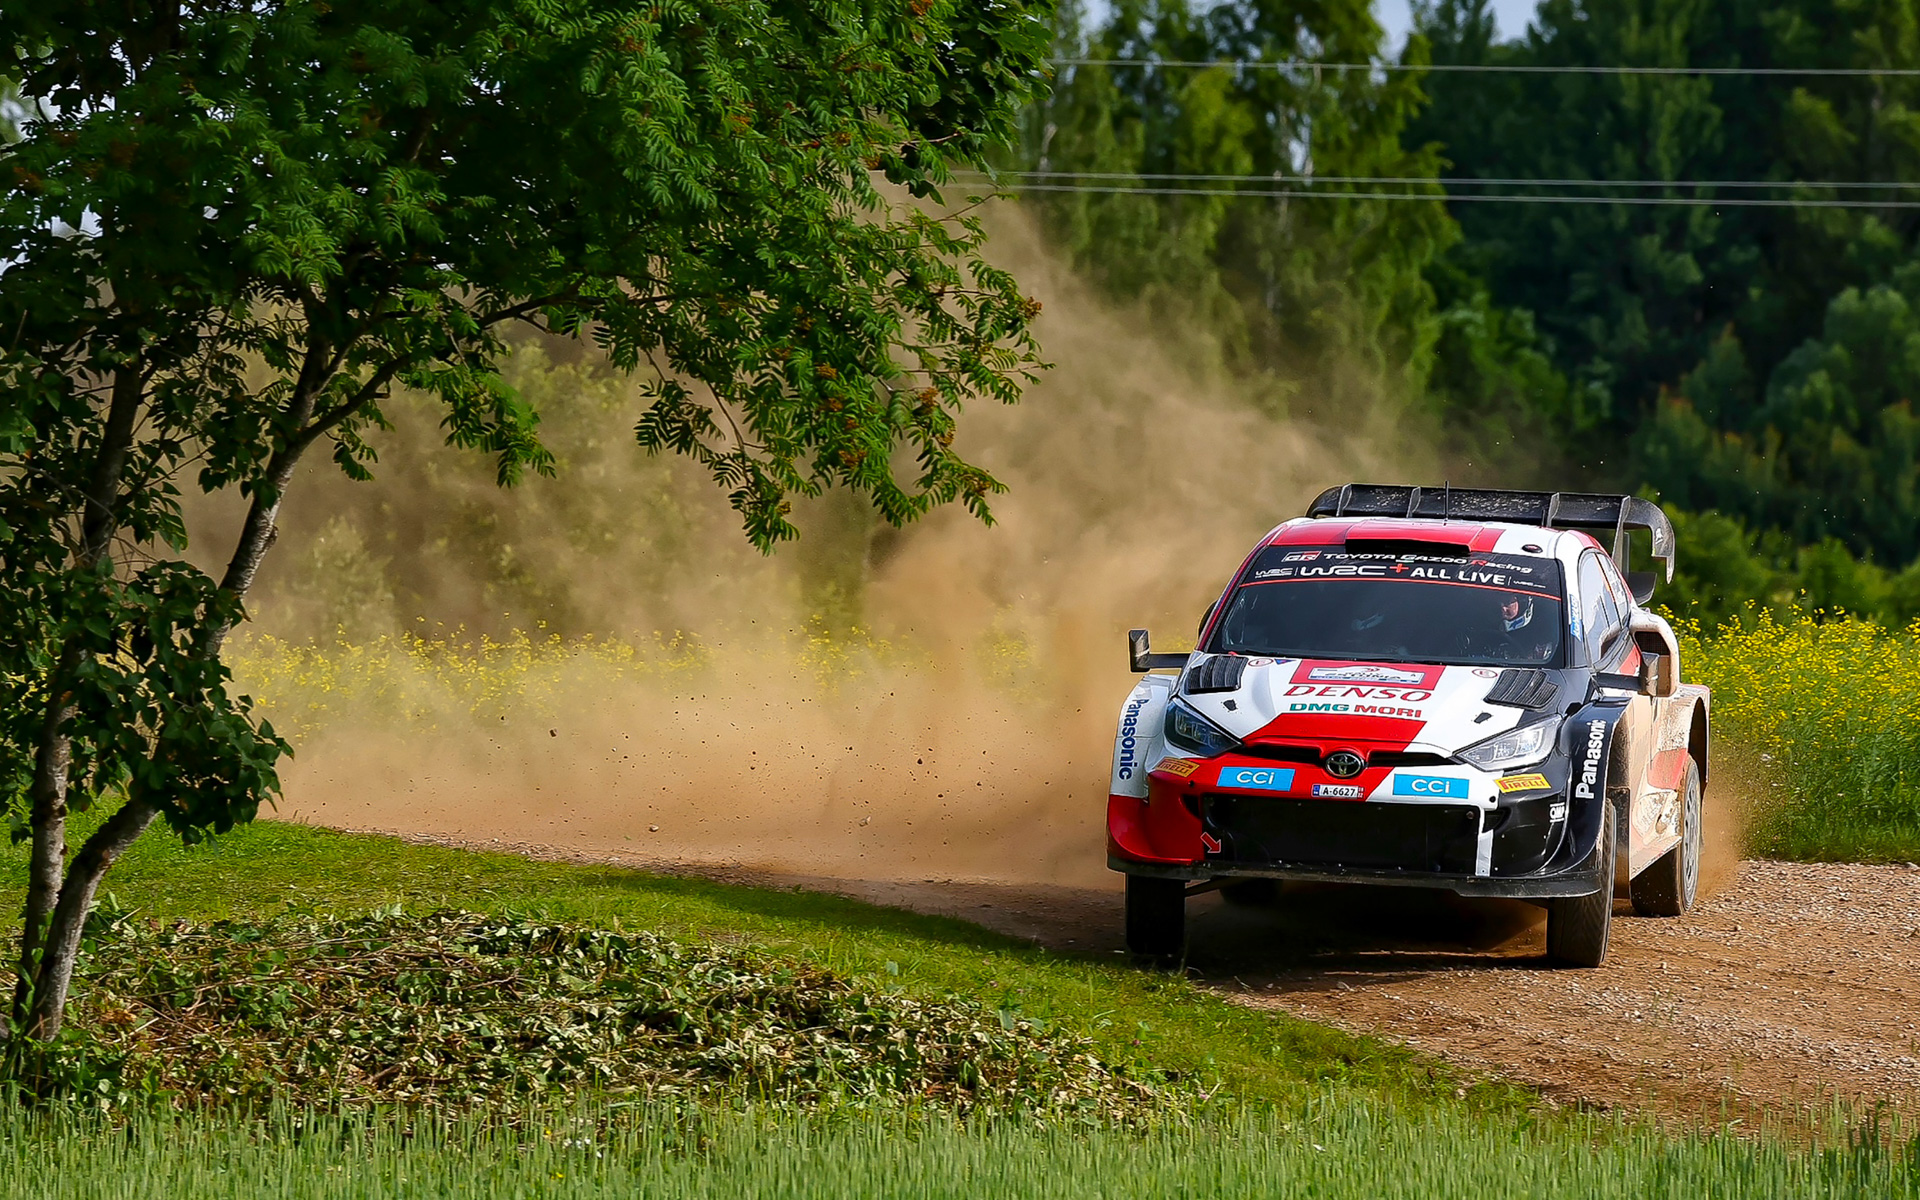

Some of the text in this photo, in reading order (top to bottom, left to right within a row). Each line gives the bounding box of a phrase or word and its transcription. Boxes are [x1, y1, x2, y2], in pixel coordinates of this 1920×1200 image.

[1400, 554, 1468, 564] GAZOO
[1471, 559, 1533, 574] Racing
[1300, 566, 1387, 576] WRC
[1410, 567, 1451, 579] ALL
[1458, 571, 1506, 585] LIVE
[1283, 685, 1432, 702] DENSO
[1289, 703, 1422, 718] DMG MORI
[1119, 699, 1149, 780] Panasonic
[1236, 770, 1275, 785] CCi
[1498, 776, 1545, 790] PIRELLI
[1322, 786, 1356, 797] A-6627
[1411, 778, 1450, 794] CCi
